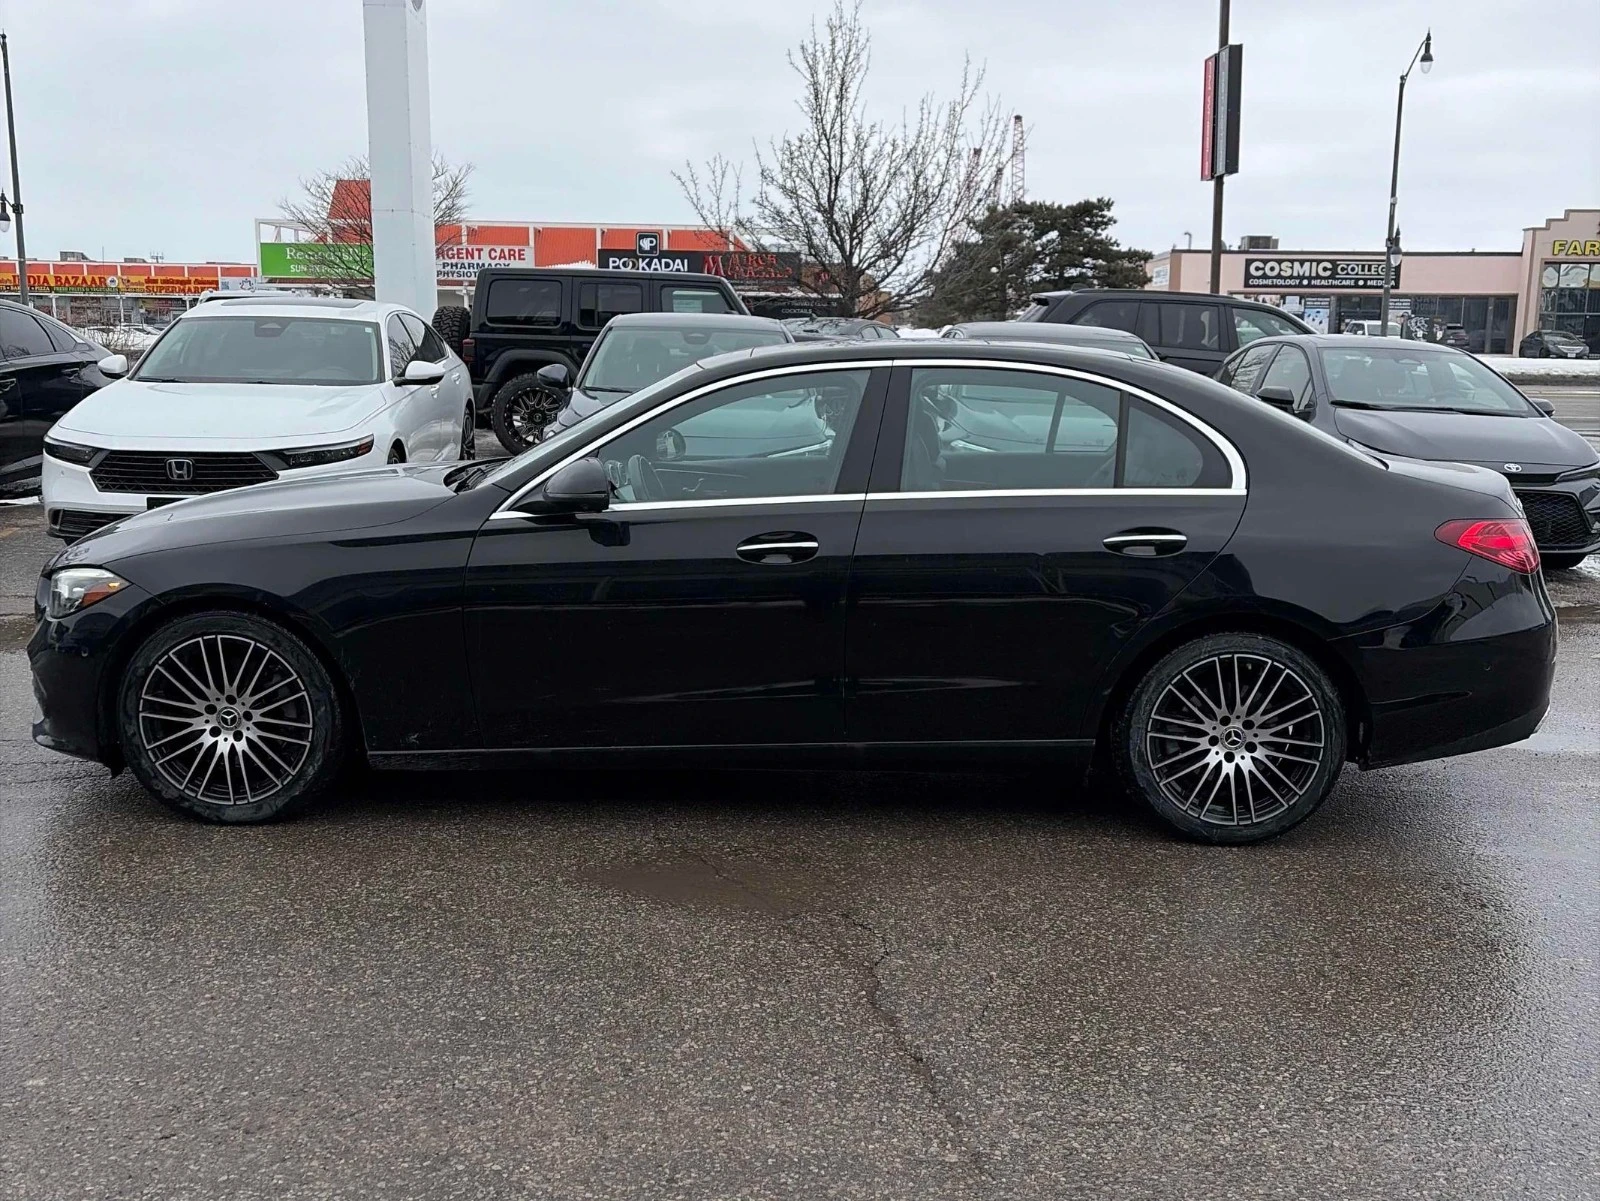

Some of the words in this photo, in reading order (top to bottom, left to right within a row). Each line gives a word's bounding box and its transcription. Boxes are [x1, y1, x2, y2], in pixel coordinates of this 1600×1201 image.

[488, 248, 526, 261] CARE
[1552, 240, 1600, 256] FAR
[1249, 261, 1333, 277] COSMIC
[54, 275, 107, 287] BAZAAR
